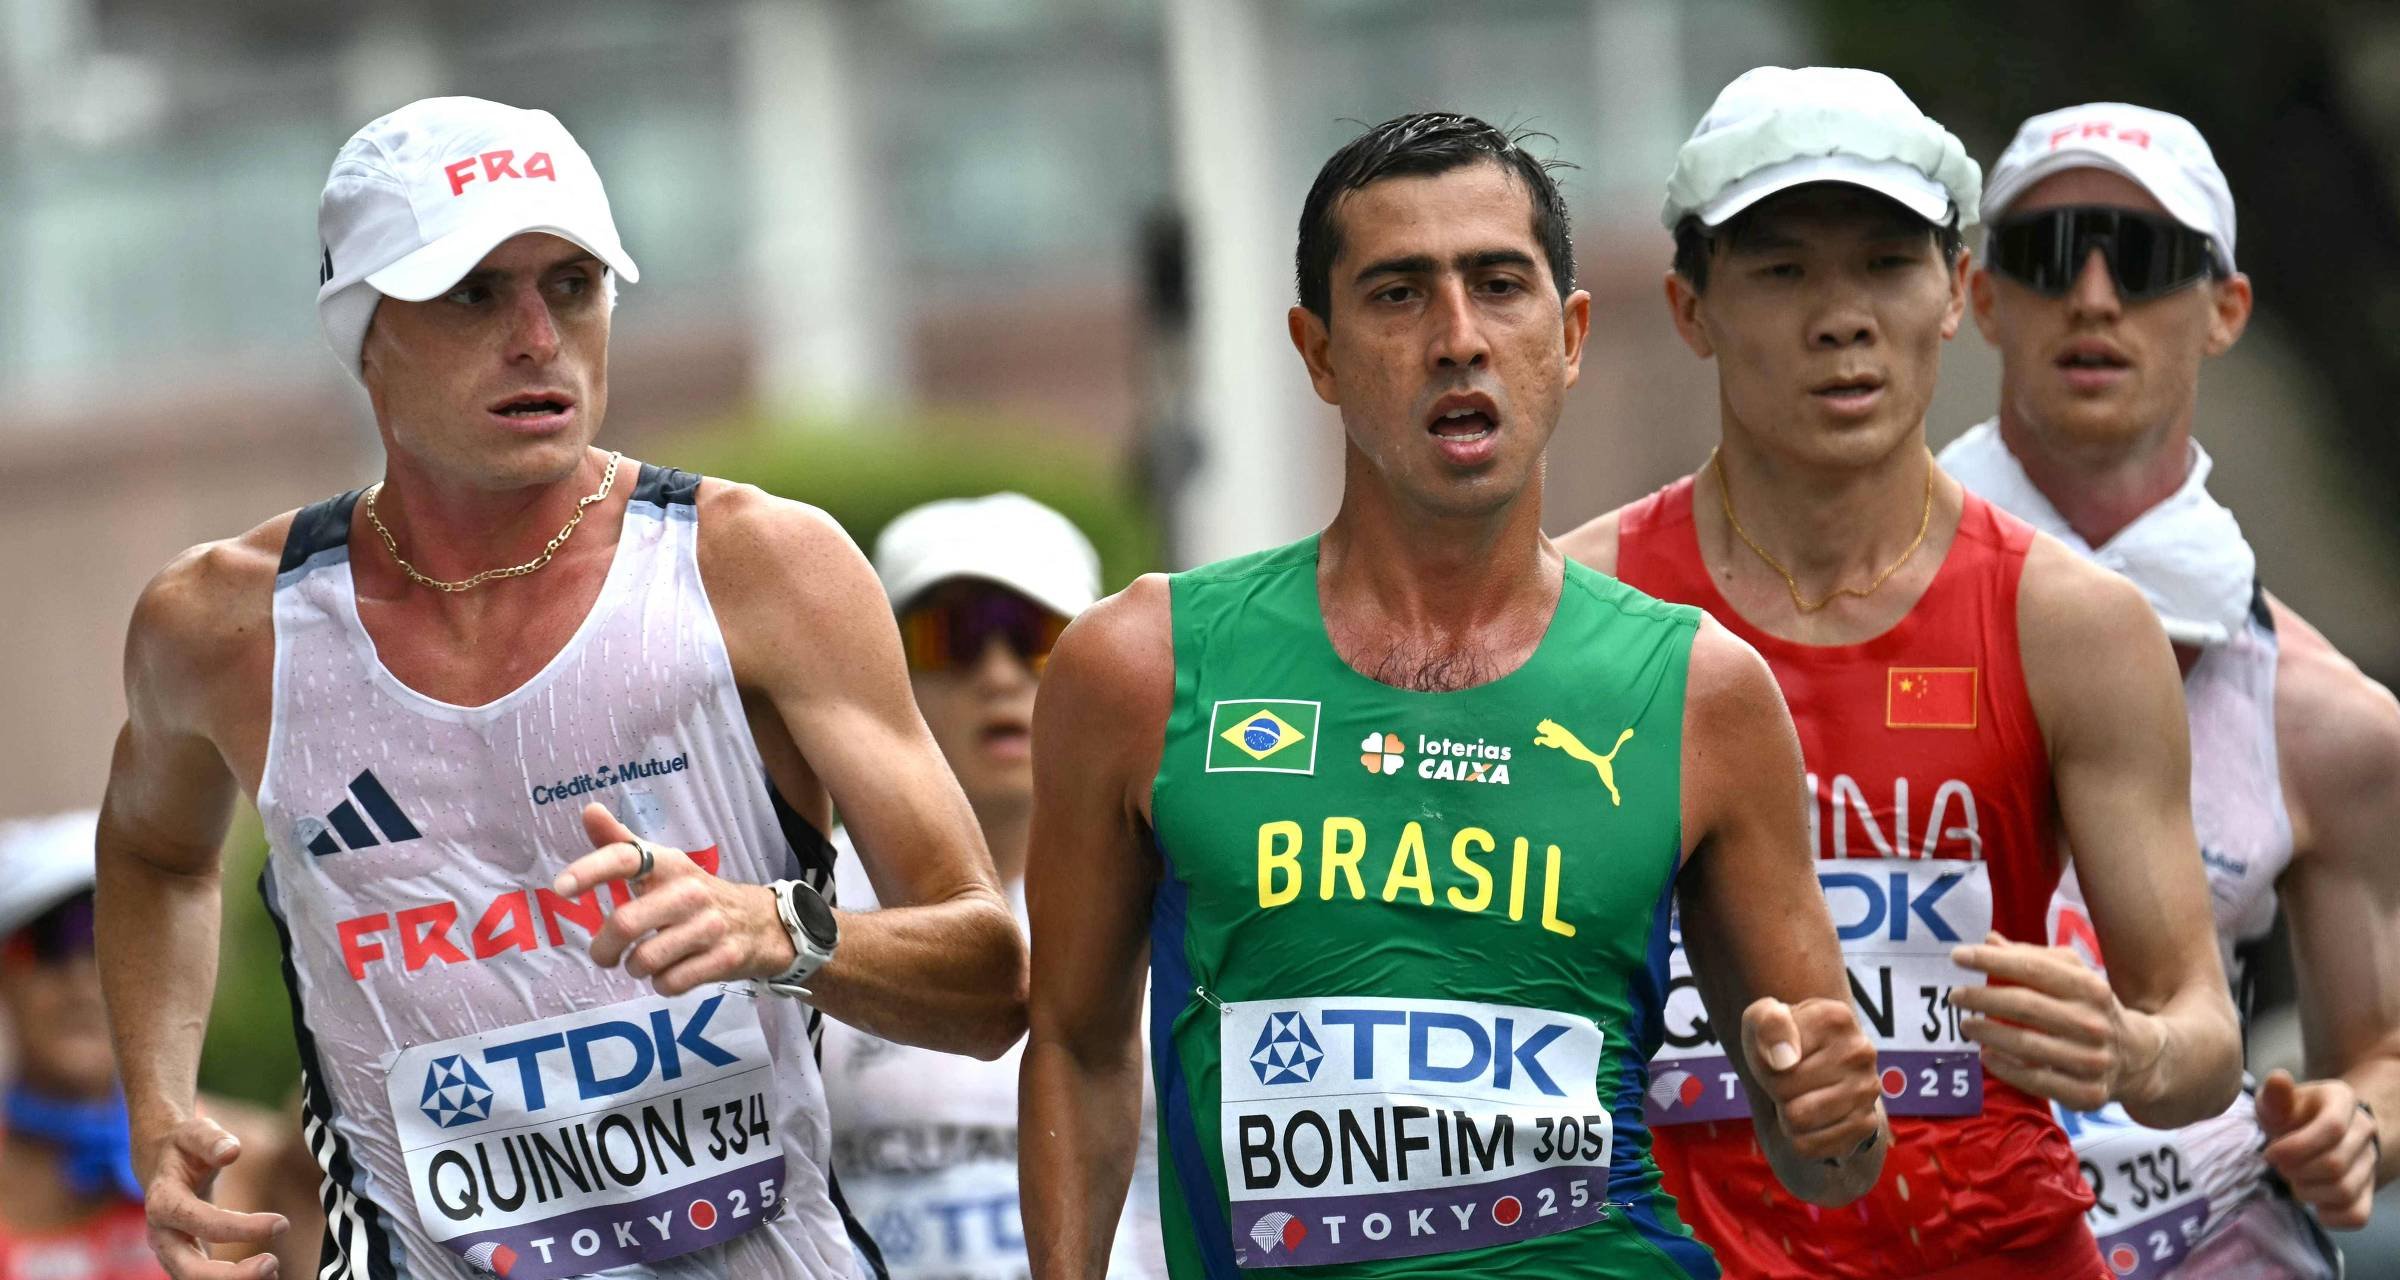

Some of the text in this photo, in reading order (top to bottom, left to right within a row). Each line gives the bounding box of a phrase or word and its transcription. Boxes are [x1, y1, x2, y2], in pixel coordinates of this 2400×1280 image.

[444, 149, 556, 197] FRA
[532, 752, 689, 805] Crédit Mutuel
[1418, 734, 1512, 761] loterias
[1418, 758, 1510, 785] CAIXA
[1806, 772, 1983, 860] INA
[336, 843, 720, 983] FRAN
[1256, 816, 1576, 938] BRASIL
[1817, 871, 1966, 942] DK
[483, 993, 741, 1113] TDK
[1321, 1008, 1572, 1097] TDK
[428, 1092, 771, 1221] QUINION 334
[1238, 1105, 1602, 1190] BONFIM 305
[2117, 1145, 2193, 1210] 332
